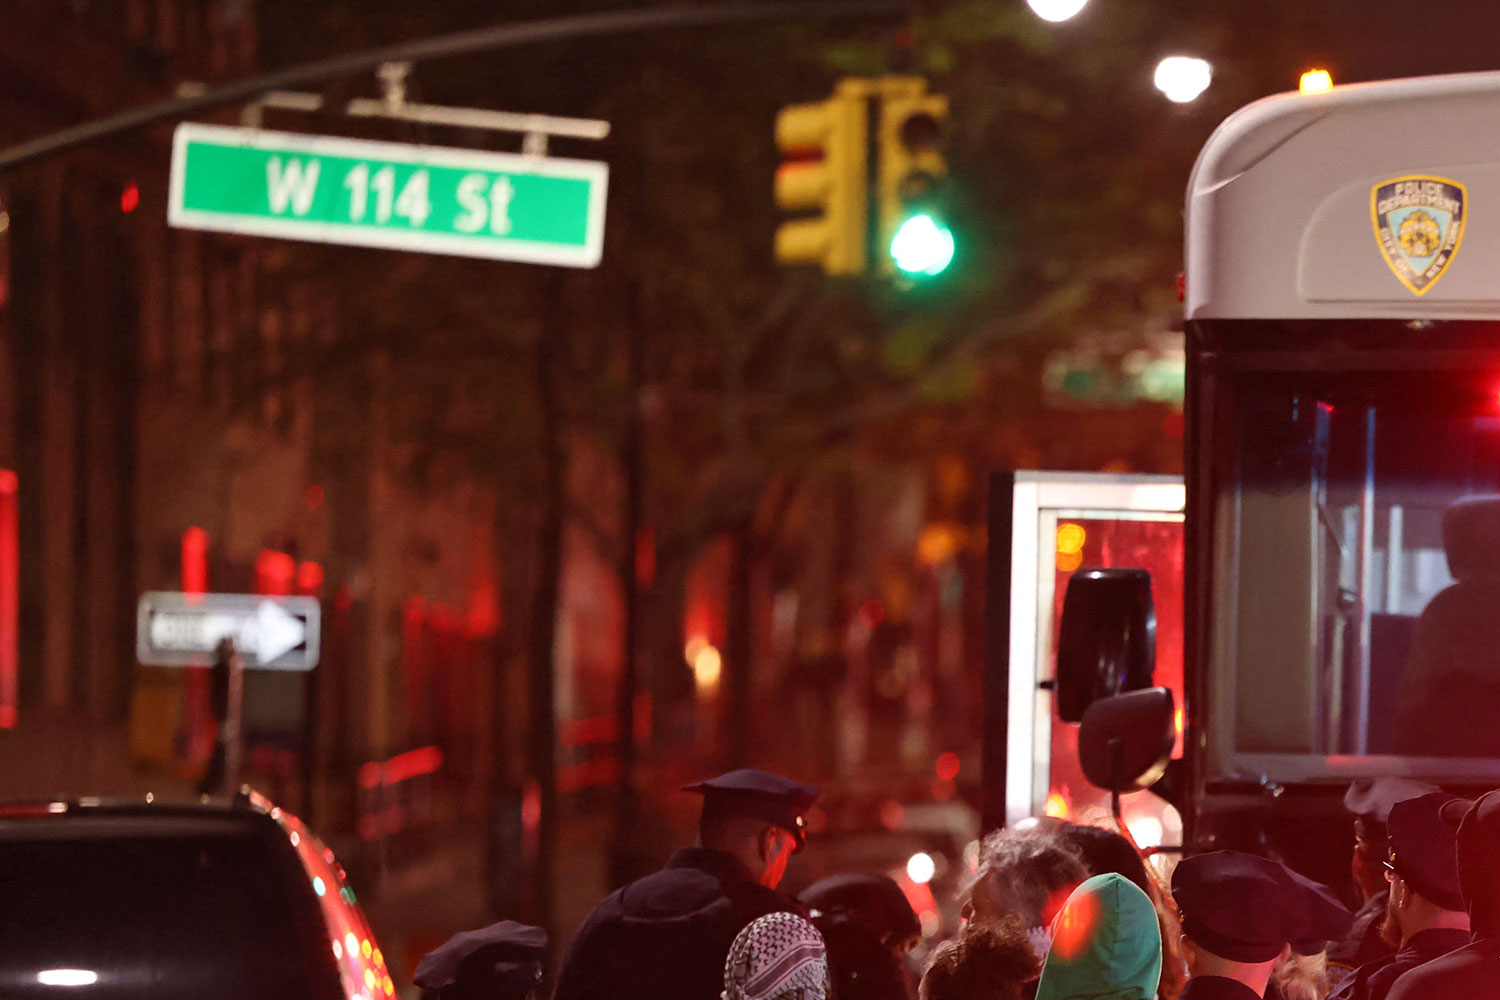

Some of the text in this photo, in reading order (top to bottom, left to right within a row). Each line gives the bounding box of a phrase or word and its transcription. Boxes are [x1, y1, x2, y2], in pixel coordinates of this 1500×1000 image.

[266, 155, 514, 236] W 114 St
